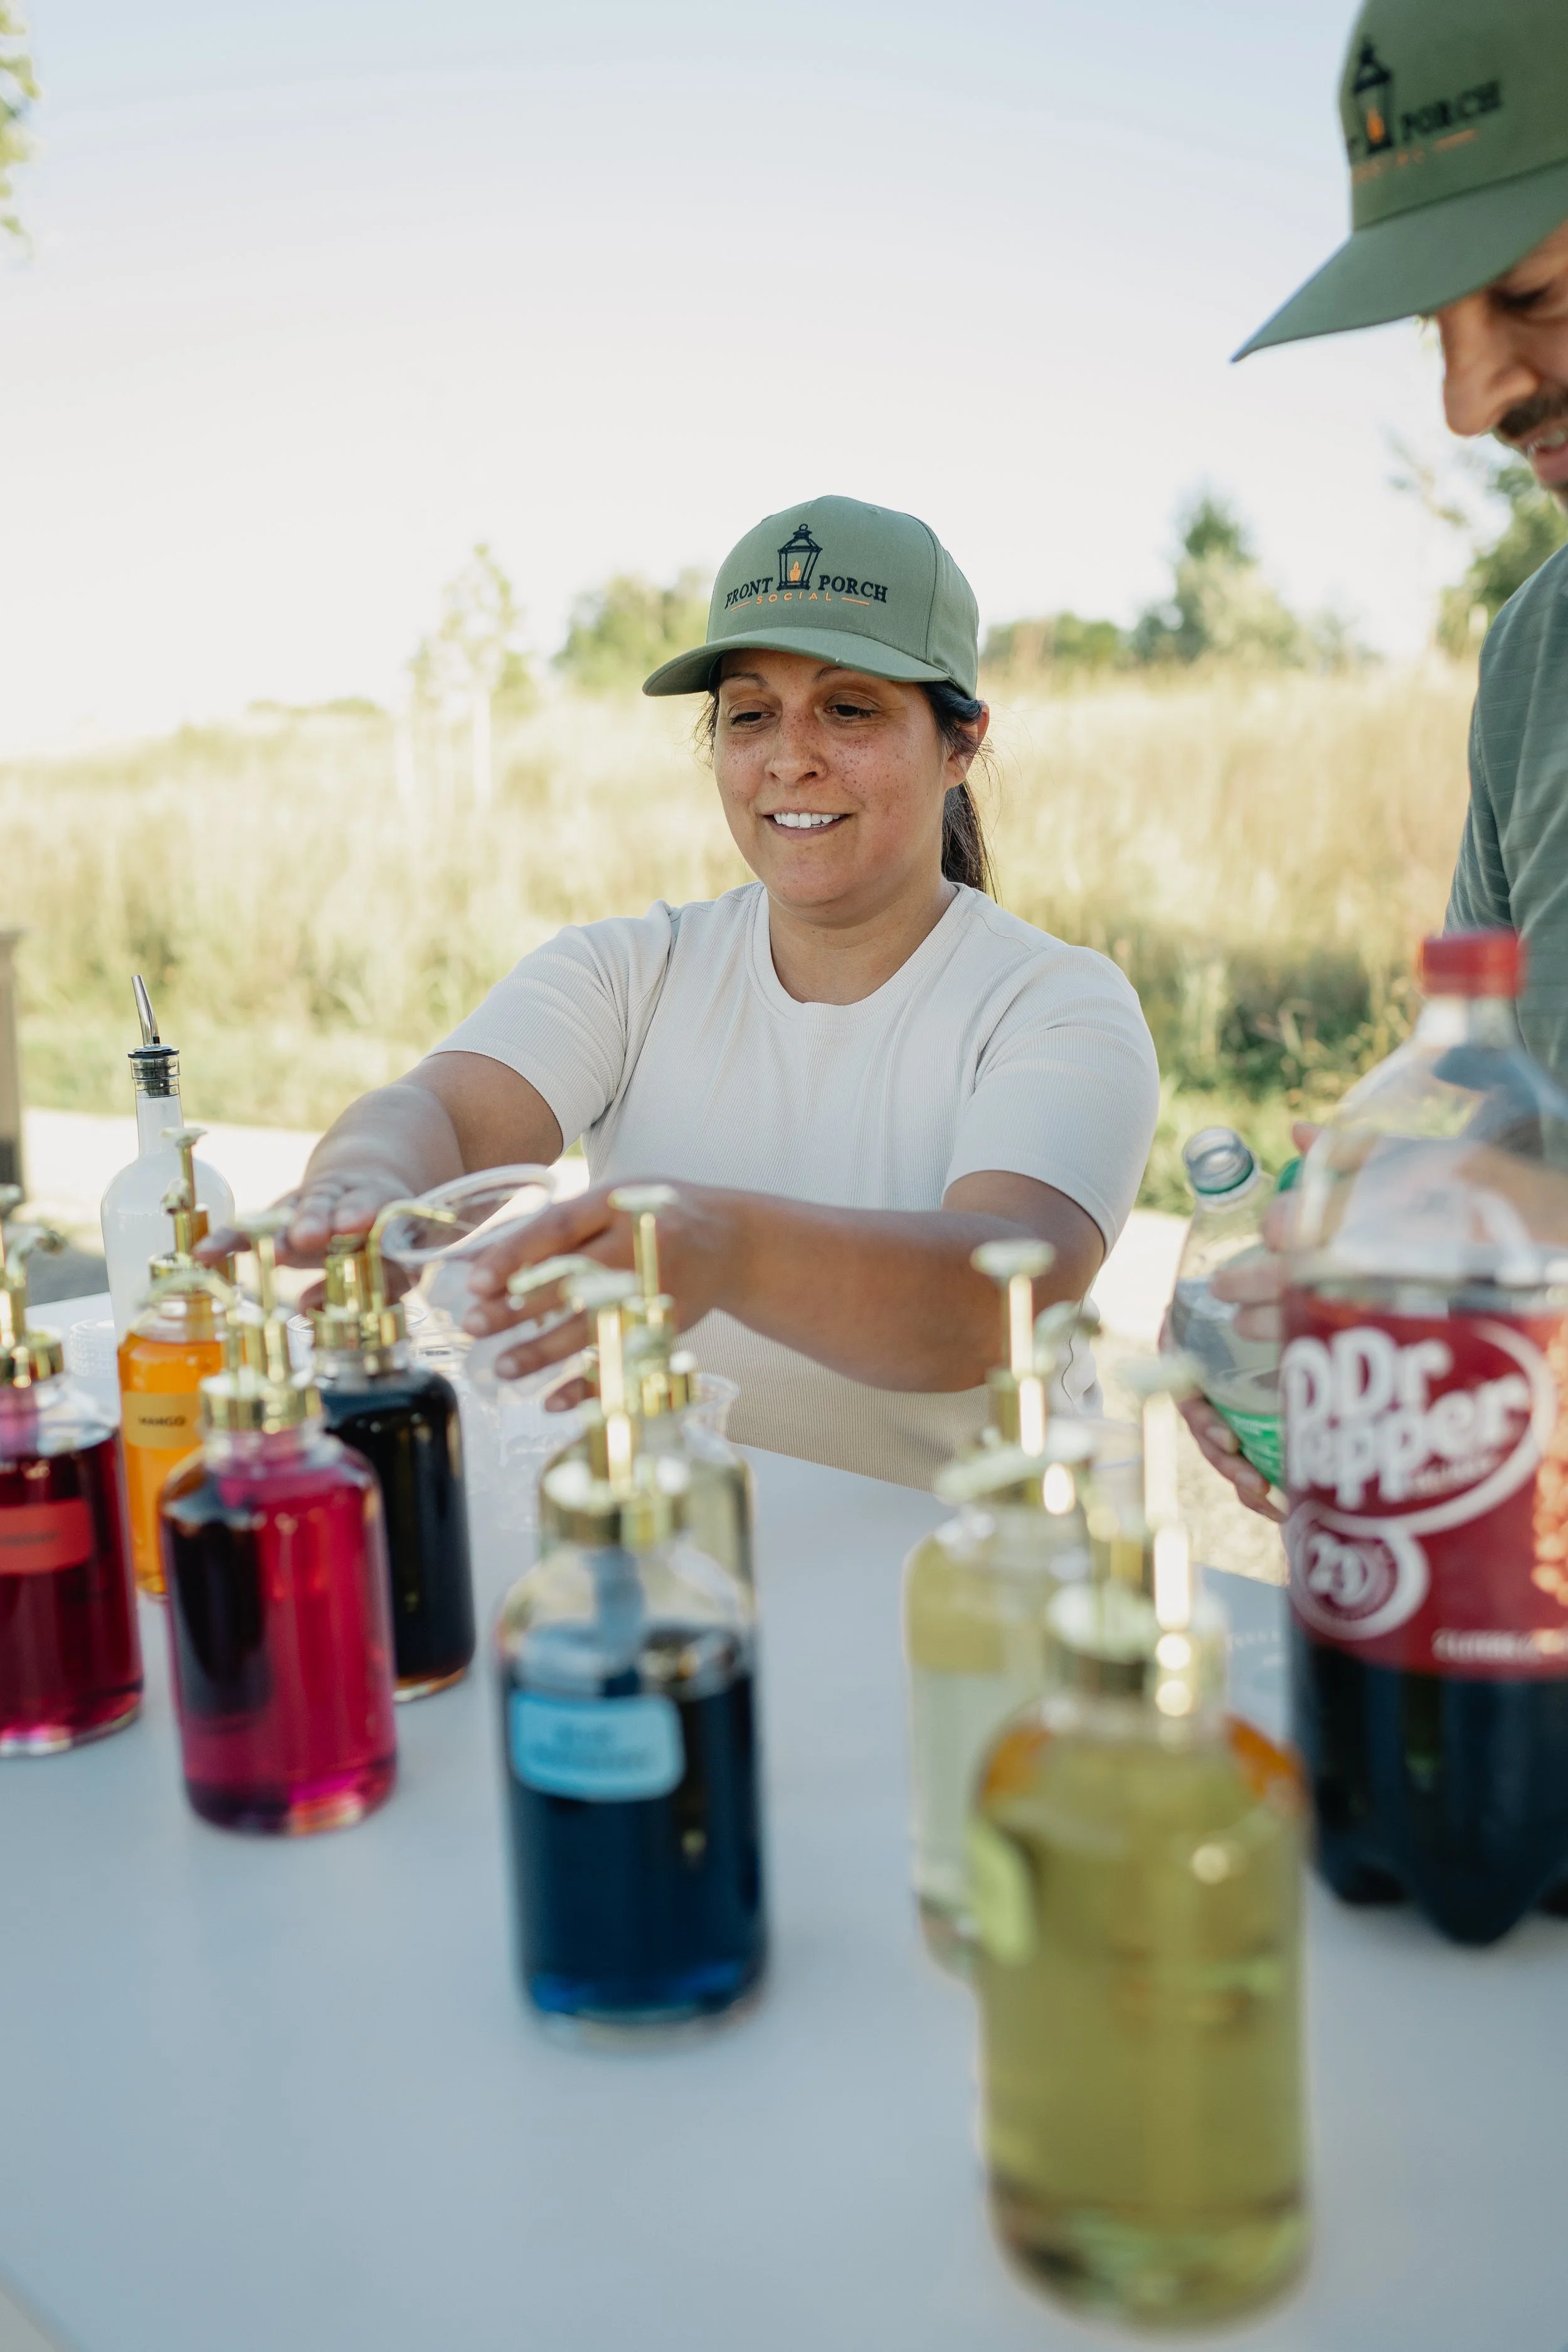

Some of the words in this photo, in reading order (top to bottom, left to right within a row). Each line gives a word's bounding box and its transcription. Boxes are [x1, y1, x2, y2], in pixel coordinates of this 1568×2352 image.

[725, 577, 773, 609] FRONT
[818, 575, 888, 603] PORCH
[756, 591, 832, 605] SOCIAL
[1330, 1325, 1453, 1417] Dr
